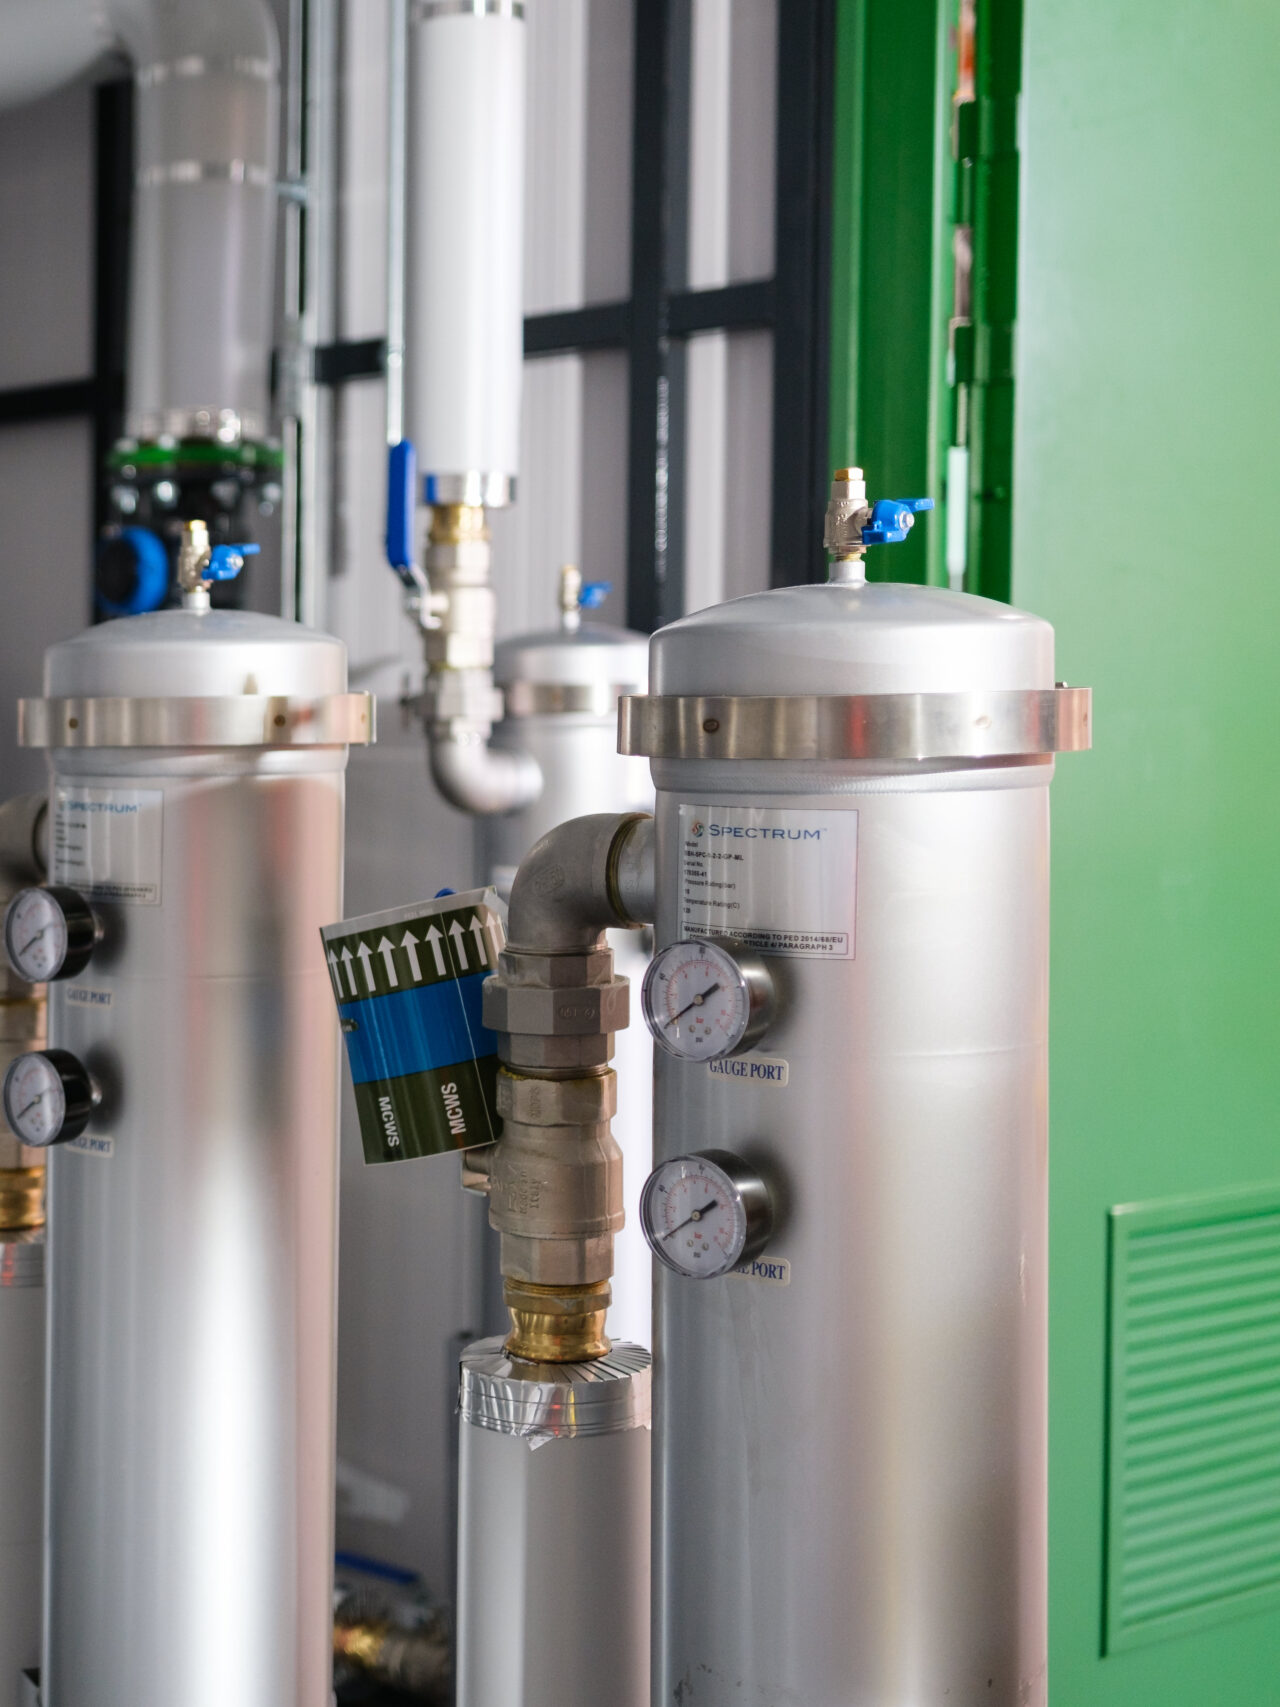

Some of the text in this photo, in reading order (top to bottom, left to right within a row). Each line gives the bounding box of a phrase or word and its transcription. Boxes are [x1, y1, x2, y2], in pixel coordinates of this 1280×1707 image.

[772, 933, 782, 941] TO
[783, 934, 800, 942] PED
[779, 942, 826, 951] PARAGRAPH
[709, 1058, 784, 1081] GAUGE PORT
[441, 1082, 467, 1135] MCWS
[378, 1096, 400, 1148] MCWS
[752, 1261, 786, 1280] PORT
